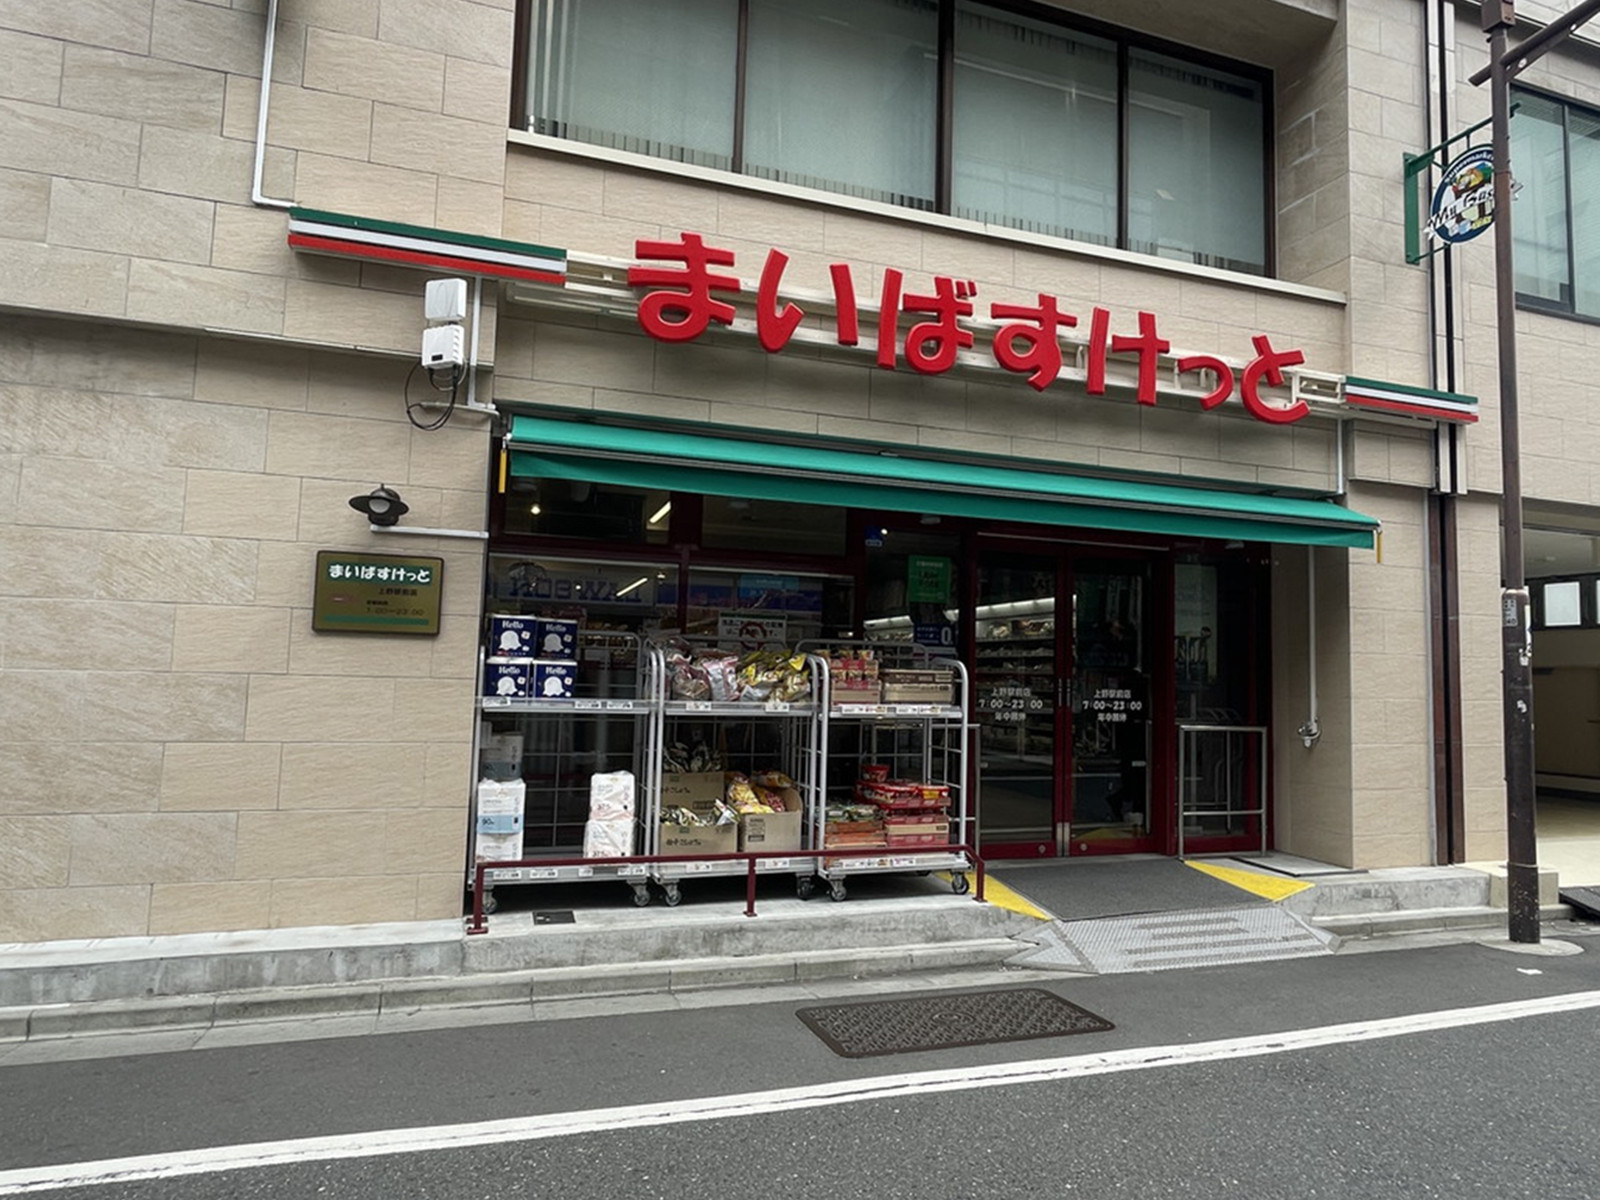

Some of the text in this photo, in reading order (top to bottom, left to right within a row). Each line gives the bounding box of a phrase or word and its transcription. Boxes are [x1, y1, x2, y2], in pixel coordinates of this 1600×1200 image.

[627, 231, 1310, 424] まいばすけっと
[329, 563, 431, 583] まいばすけっと
[502, 620, 524, 629] Hello
[545, 624, 567, 632] Hello
[498, 666, 521, 675] Hello
[545, 666, 567, 675] Hello
